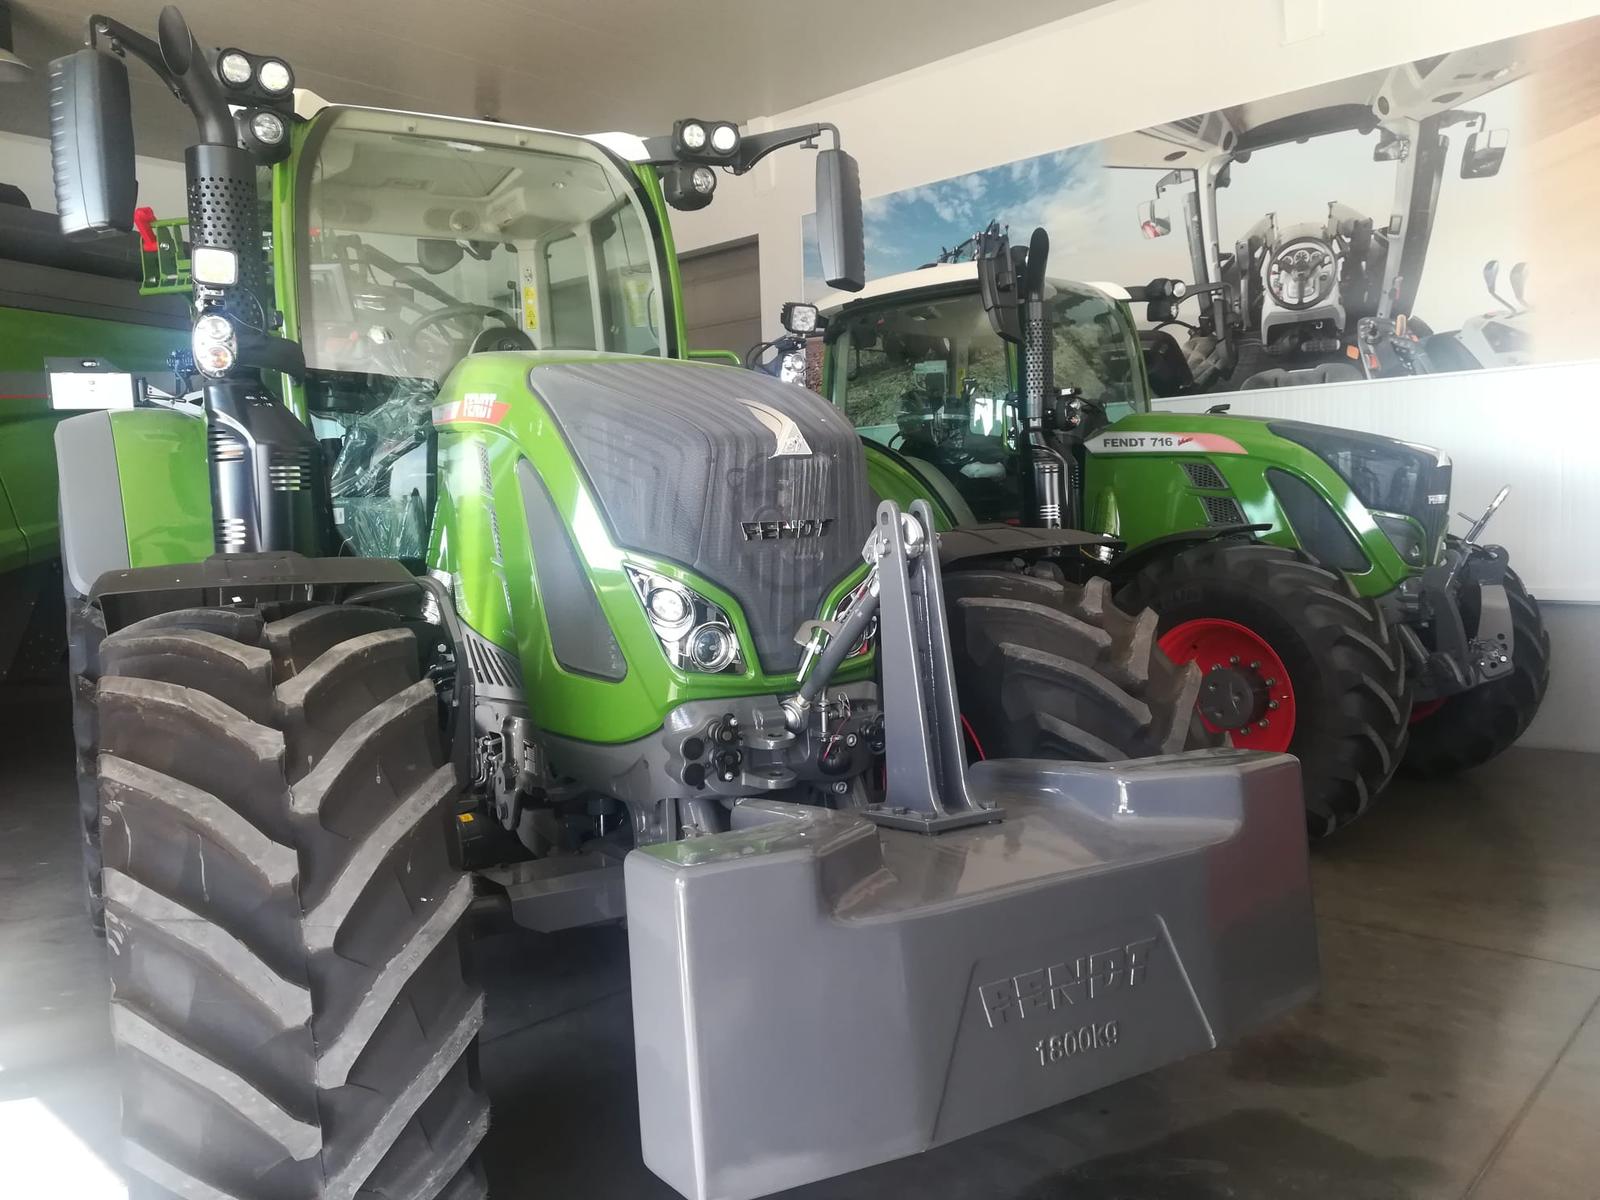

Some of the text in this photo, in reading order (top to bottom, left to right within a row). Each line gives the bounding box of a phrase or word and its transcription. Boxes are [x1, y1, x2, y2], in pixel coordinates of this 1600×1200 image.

[1103, 438, 1146, 448] FENDT
[1150, 437, 1173, 447] 716
[740, 519, 836, 541] FENDT
[978, 936, 1158, 1028] FENDT
[1034, 1020, 1119, 1066] 1800kg
